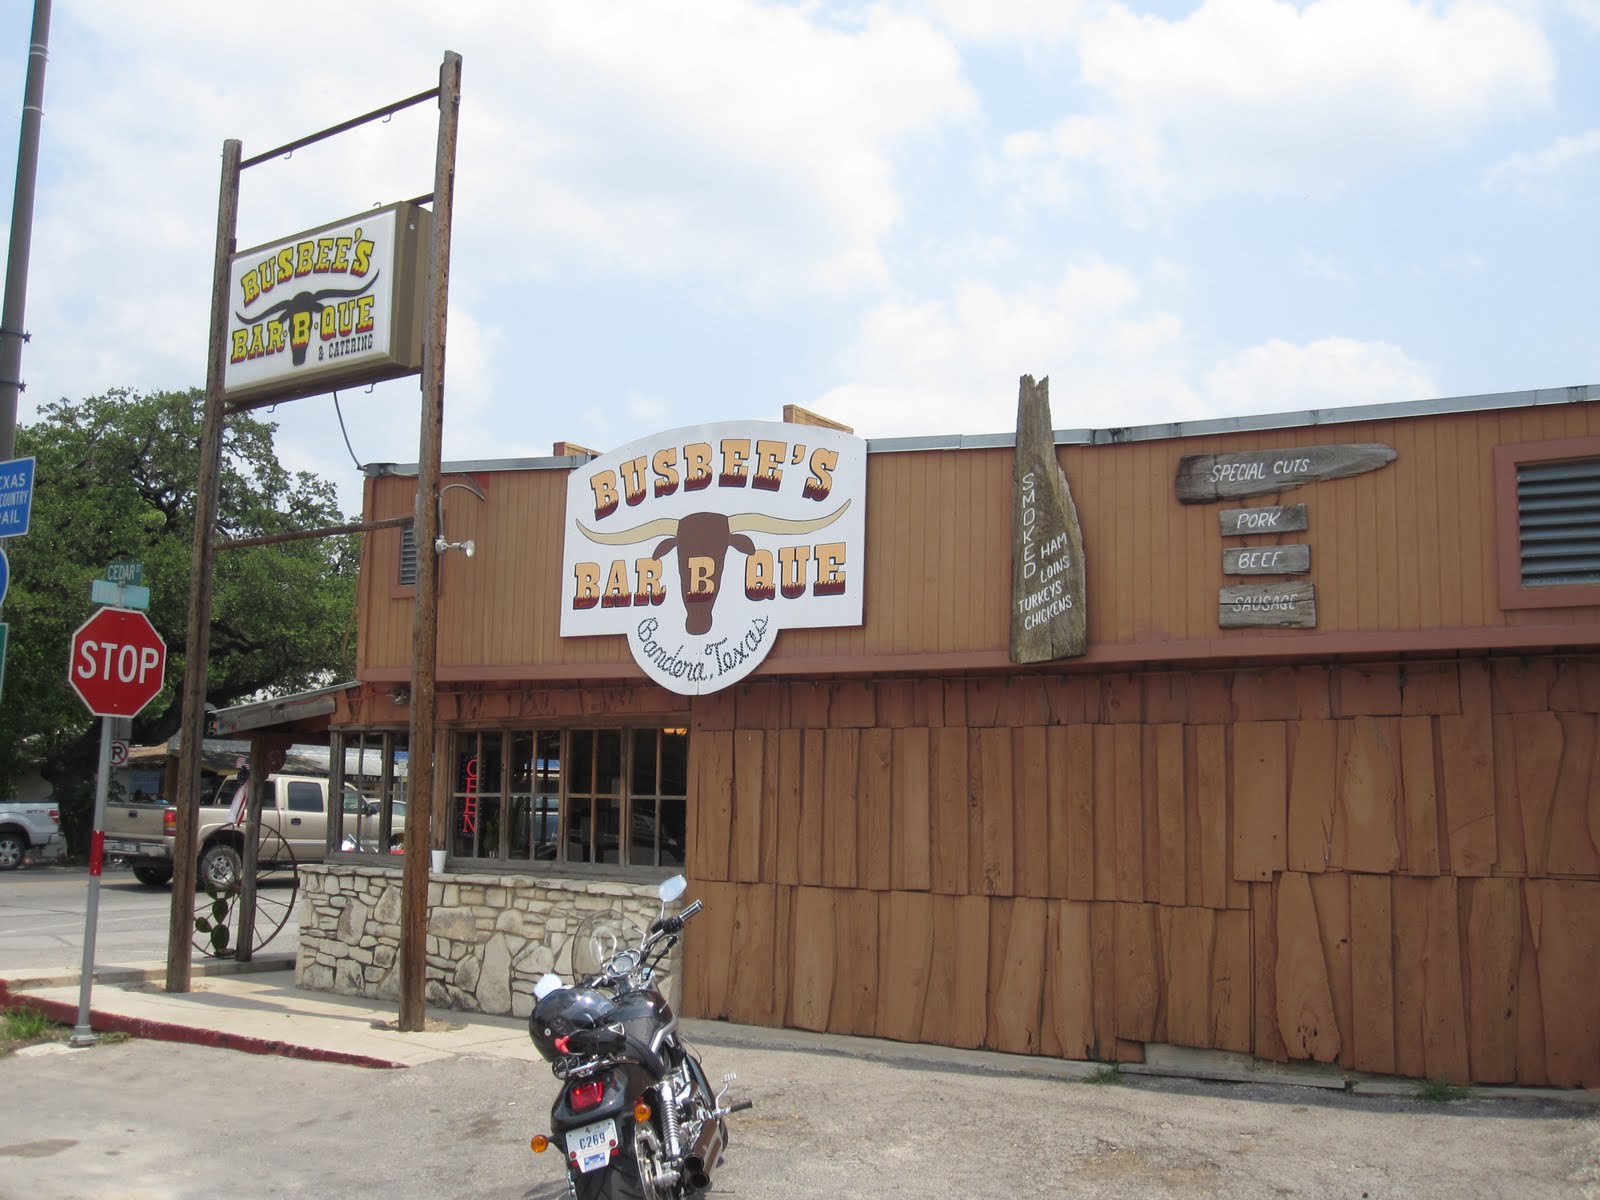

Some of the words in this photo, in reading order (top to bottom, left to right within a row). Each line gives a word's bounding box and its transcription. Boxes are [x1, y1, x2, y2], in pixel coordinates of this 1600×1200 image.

[241, 227, 375, 308] BUSBEE'S
[318, 345, 325, 361] &
[329, 333, 373, 359] CATERING
[590, 439, 839, 521] BUSBEE'S
[1210, 463, 1265, 483] SPECIAL
[1274, 459, 1310, 474] CUTS
[0, 510, 20, 525] AIL
[1022, 473, 1036, 579] SMOKED
[1237, 512, 1281, 528] PORK
[1041, 532, 1068, 560] HAM
[1238, 551, 1283, 569] BEEF
[107, 564, 135, 580] CEDAR
[573, 558, 667, 610] BAR
[686, 556, 715, 603] B
[744, 542, 846, 602] QUE
[1040, 555, 1070, 583] LOINS
[1018, 580, 1063, 614] TURKEYS
[1232, 594, 1299, 612] SAUSAGE
[1024, 595, 1073, 630] CHICKENS
[704, 614, 769, 676] Texas
[77, 640, 159, 684] STOP
[579, 1132, 606, 1150] C269
